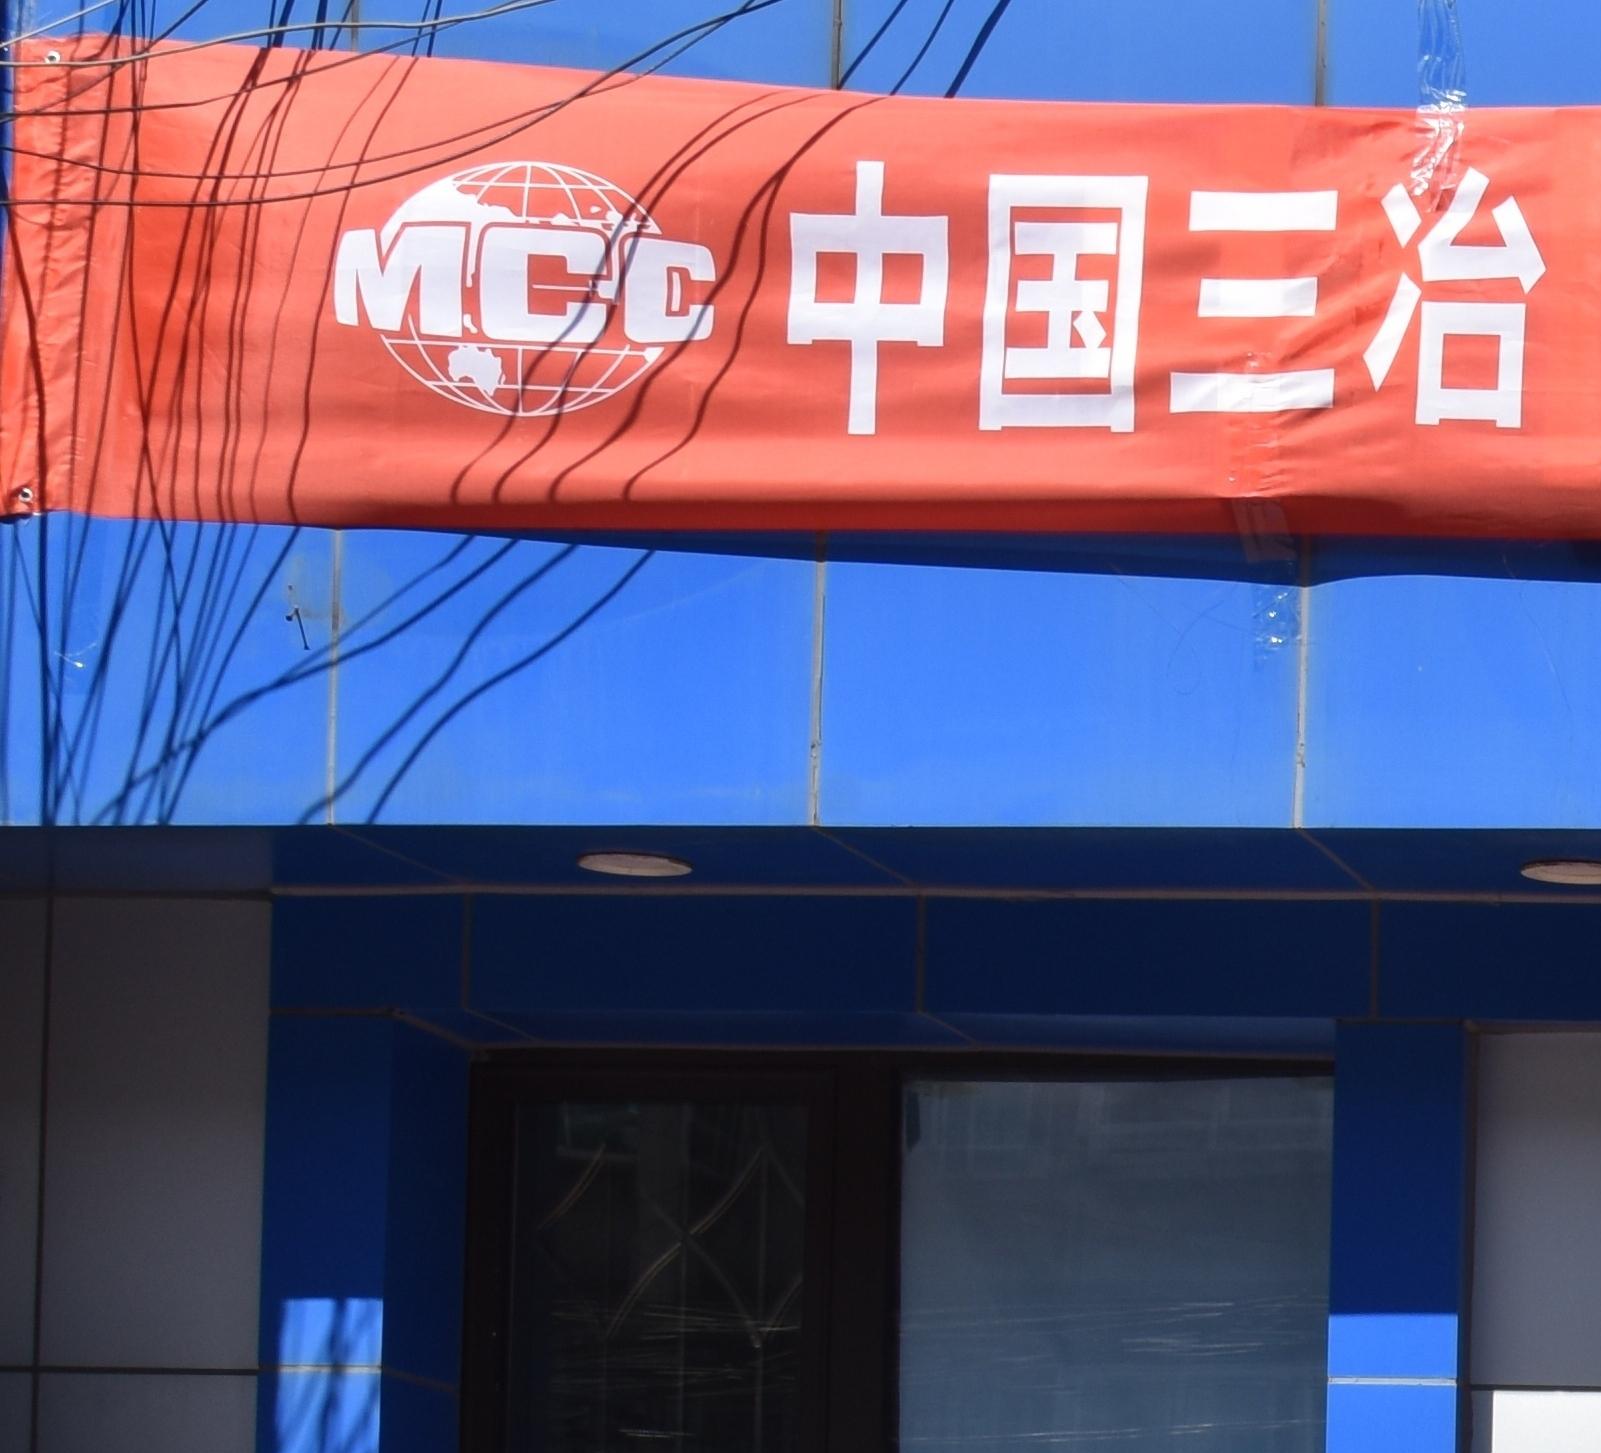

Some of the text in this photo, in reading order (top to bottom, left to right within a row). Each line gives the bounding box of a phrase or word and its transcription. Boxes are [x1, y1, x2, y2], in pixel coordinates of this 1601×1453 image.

[334, 221, 716, 344] MCC
[787, 160, 1548, 436] 中国三冶
